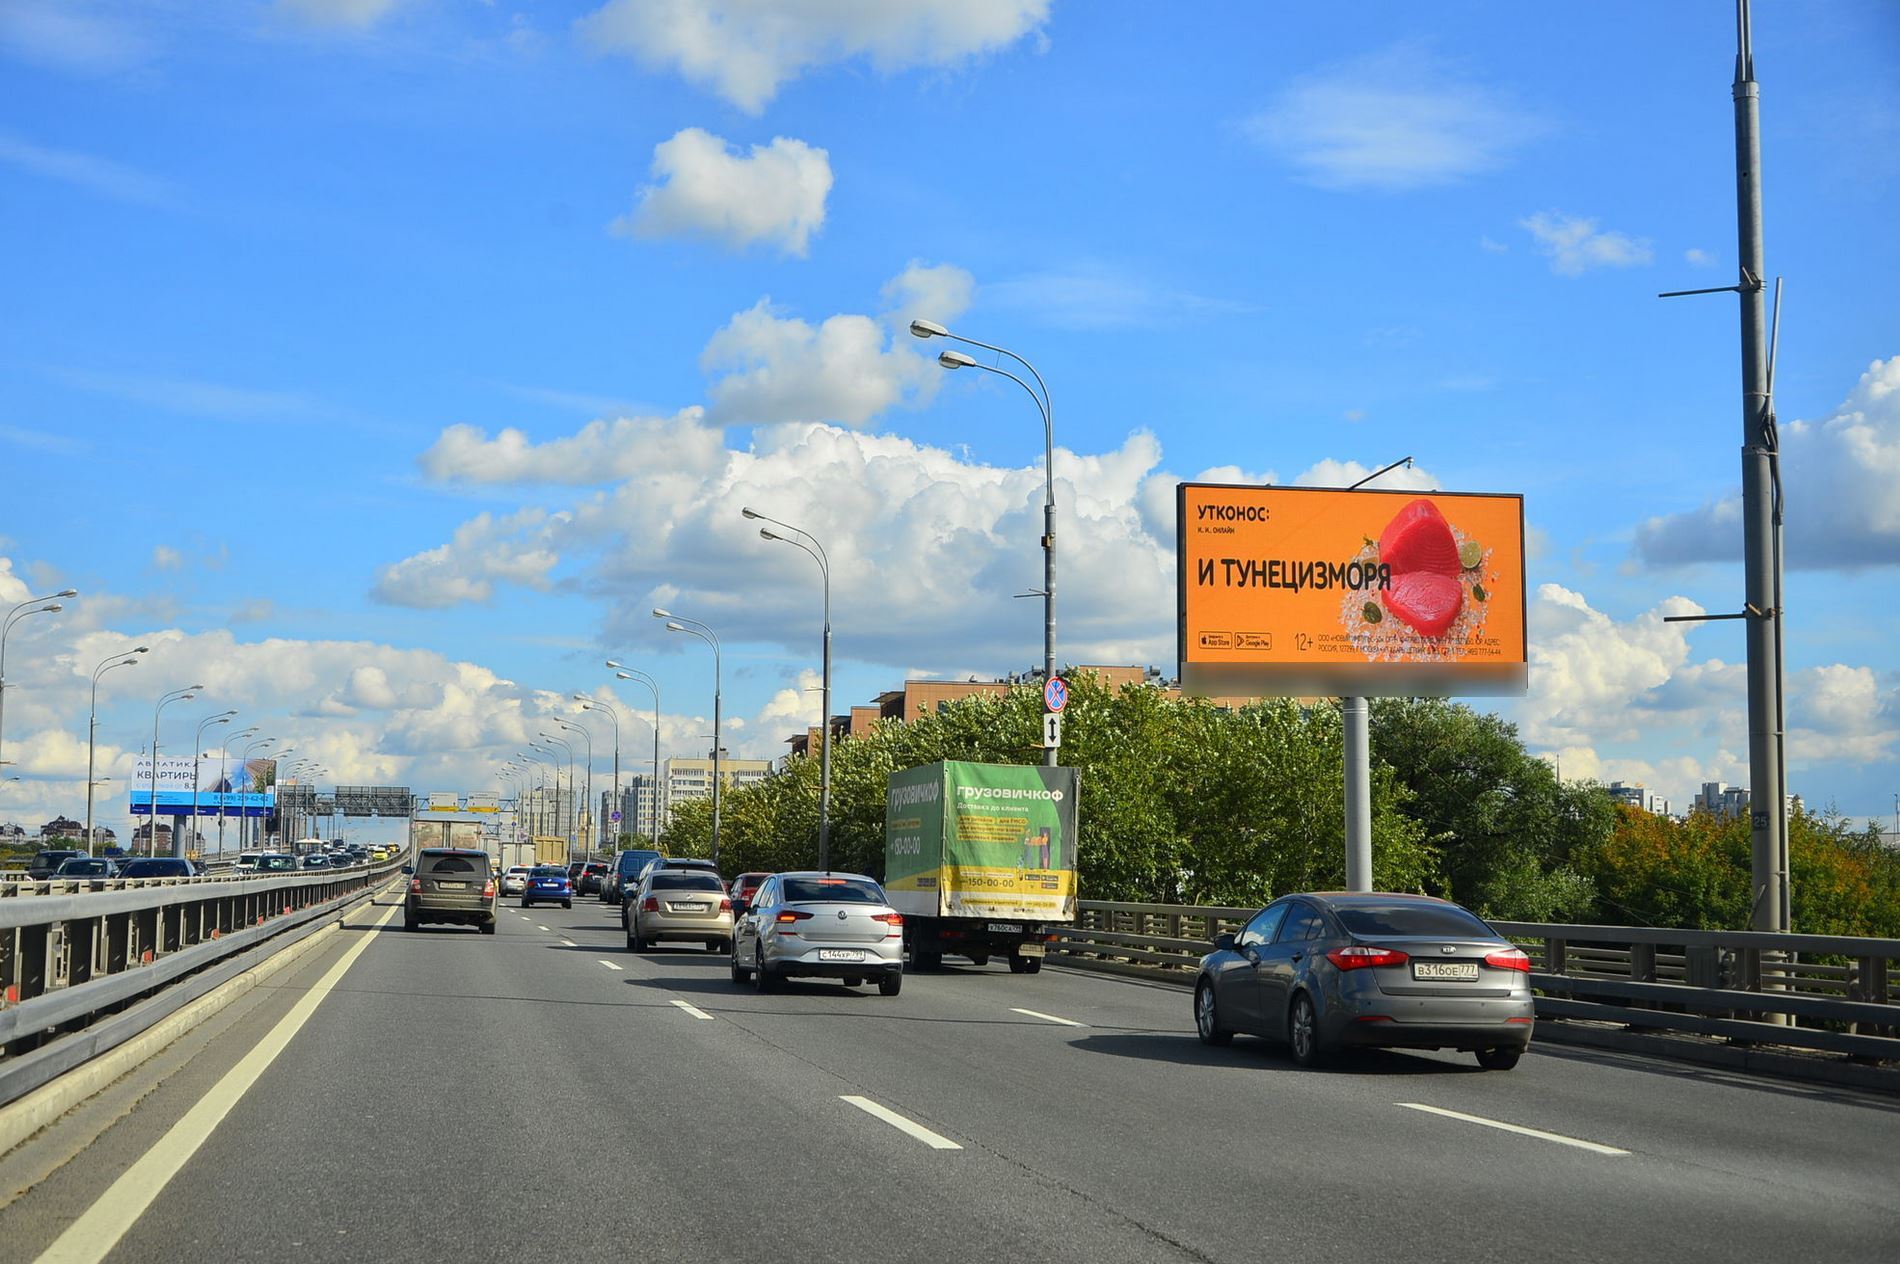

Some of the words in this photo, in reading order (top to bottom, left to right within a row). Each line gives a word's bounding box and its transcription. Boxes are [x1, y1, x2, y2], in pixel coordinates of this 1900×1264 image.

[1197, 505, 1269, 521] УТКОНОС:
[1212, 526, 1235, 534] ОНЛАЙН
[1198, 558, 1214, 586] И
[1220, 559, 1391, 593] ТУНЕЦИЗМОРЯ
[1295, 633, 1313, 650] 12+
[957, 786, 1064, 802] грузовичкоф
[957, 802, 990, 810] Доставка
[991, 804, 1000, 812] до
